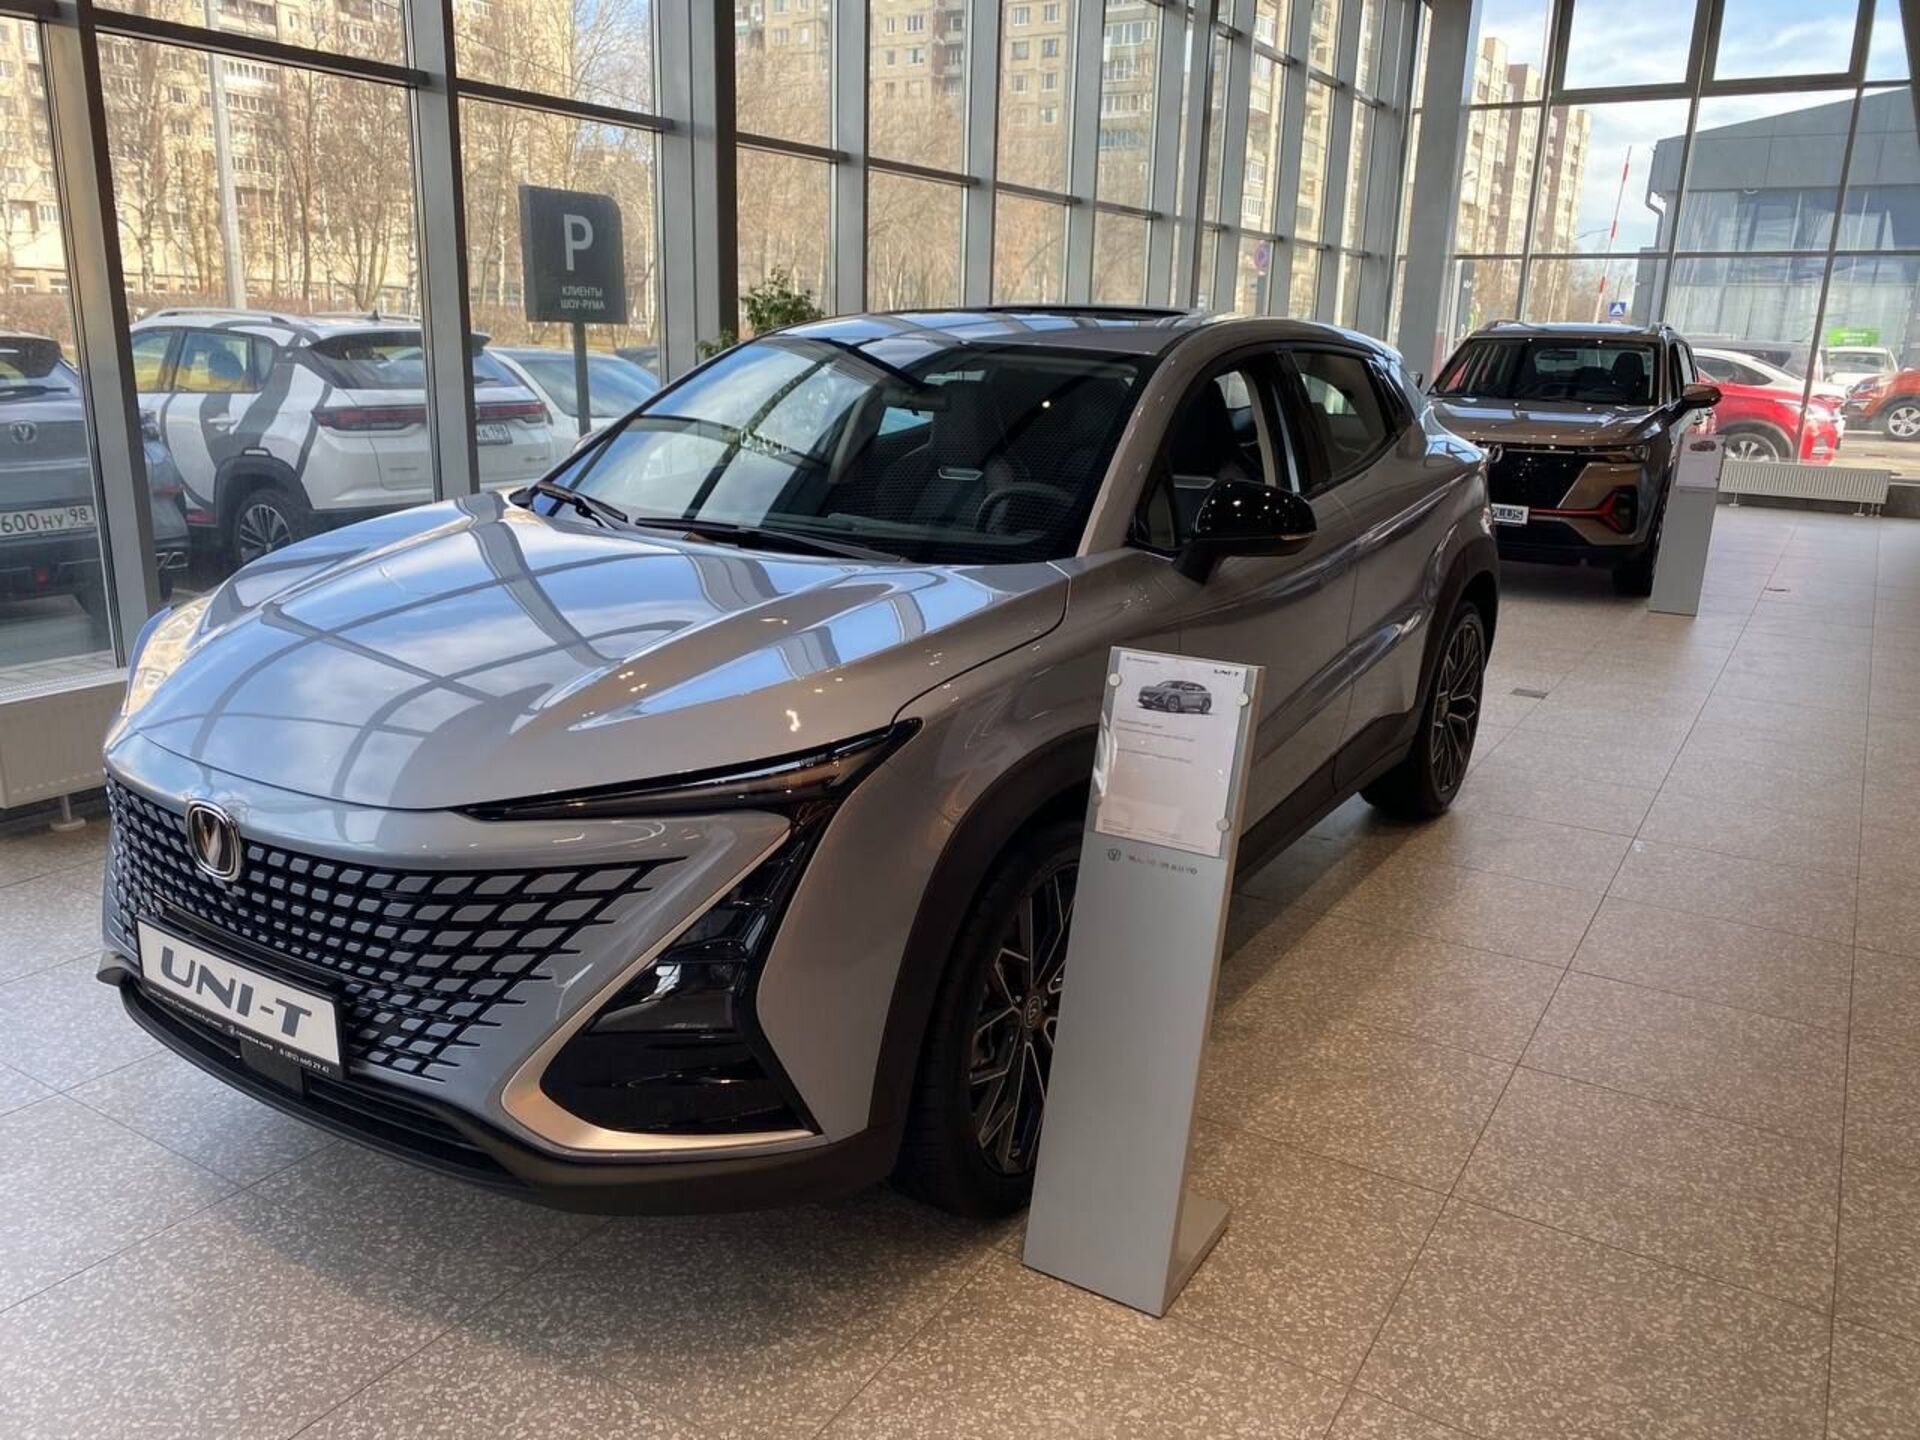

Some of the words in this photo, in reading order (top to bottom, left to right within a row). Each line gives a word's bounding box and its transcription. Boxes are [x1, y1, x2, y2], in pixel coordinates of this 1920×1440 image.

[563, 213, 594, 271] P
[560, 299, 606, 310] ШОУ-РУМА
[561, 286, 603, 297] КЛИЕНТЫ
[160, 945, 313, 1038] UNI-T
